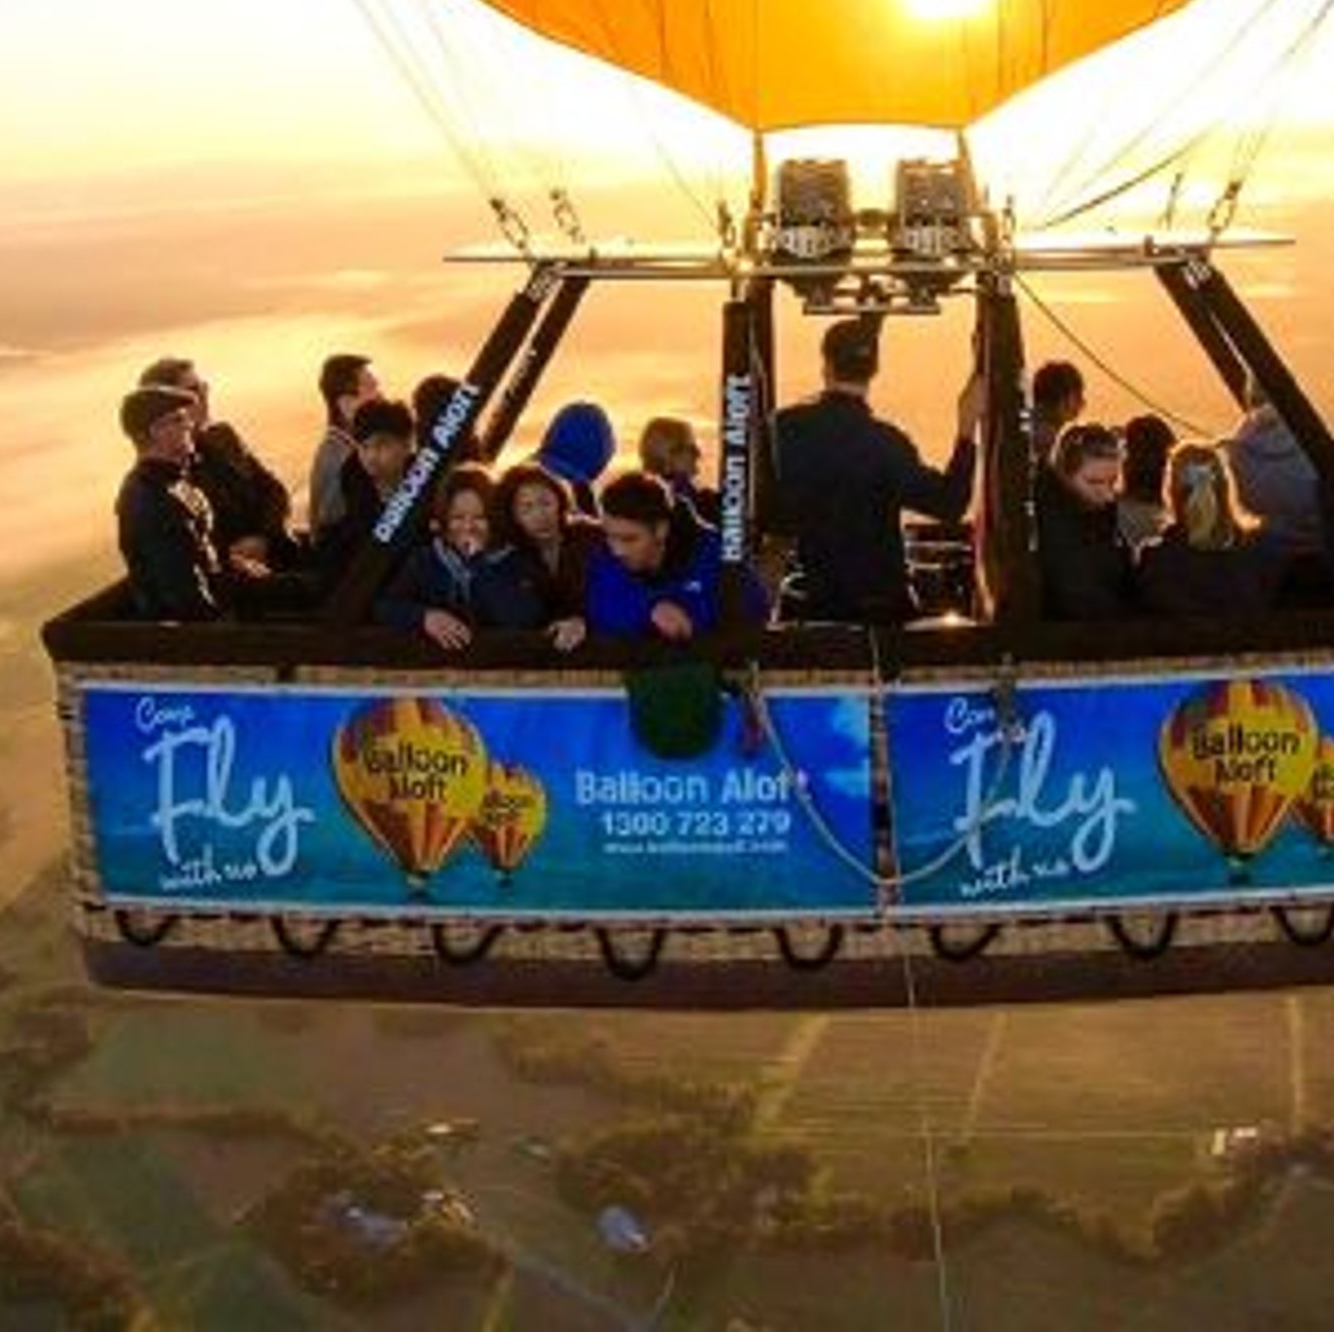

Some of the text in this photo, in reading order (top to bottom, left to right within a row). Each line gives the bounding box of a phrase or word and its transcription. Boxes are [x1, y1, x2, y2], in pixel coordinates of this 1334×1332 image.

[944, 696, 996, 735] Com
[142, 714, 317, 878] Fly
[575, 770, 709, 805] Balloon
[948, 710, 1138, 873] Fly
[602, 812, 668, 836] 1300
[677, 811, 729, 836] 723
[158, 842, 223, 891] with
